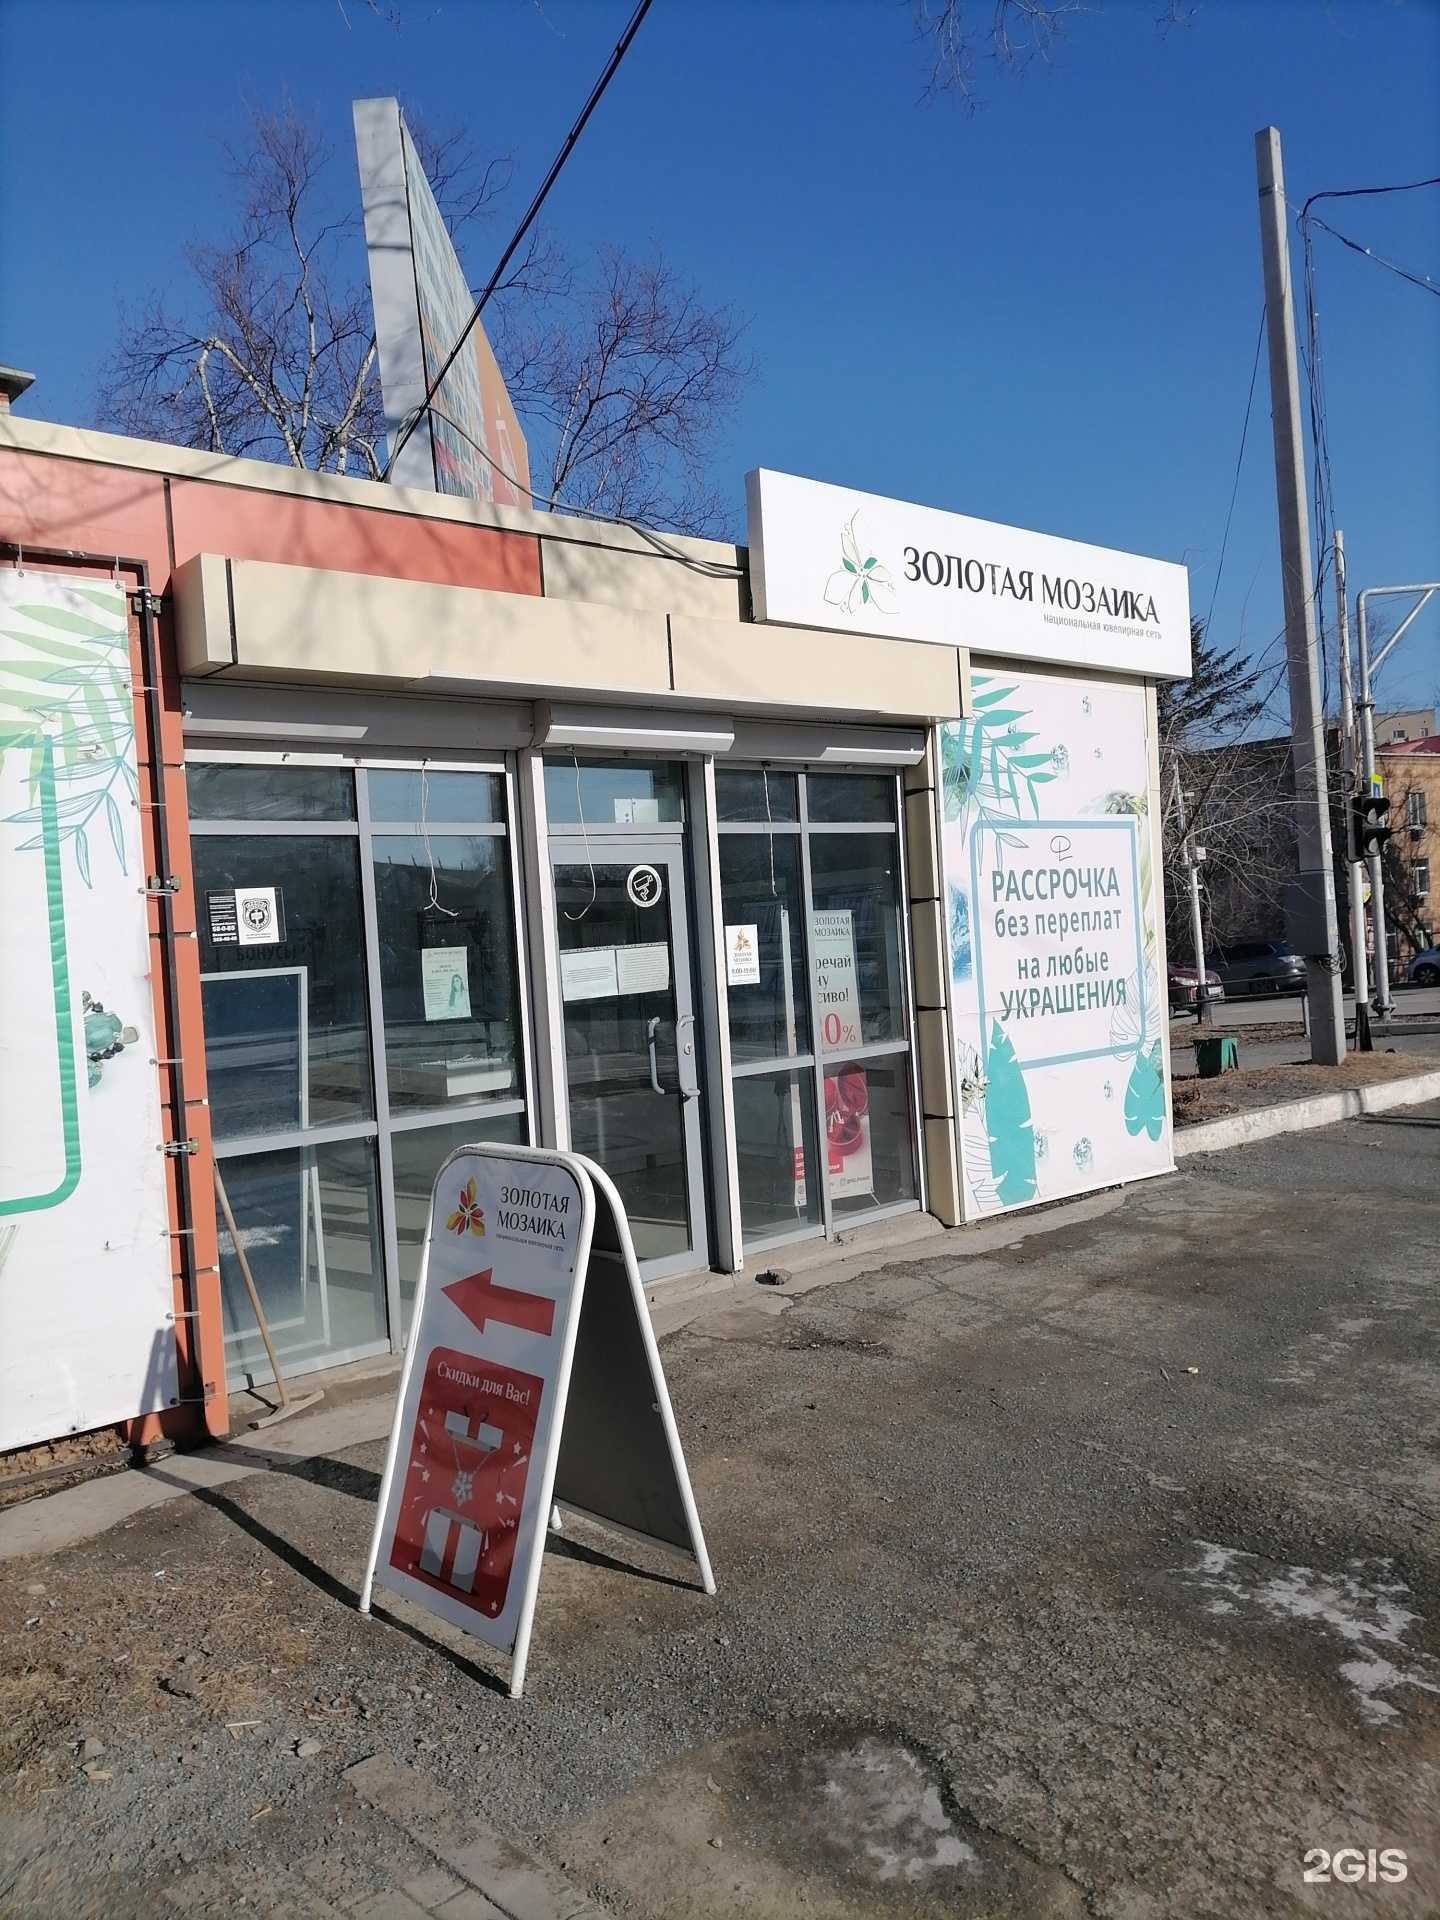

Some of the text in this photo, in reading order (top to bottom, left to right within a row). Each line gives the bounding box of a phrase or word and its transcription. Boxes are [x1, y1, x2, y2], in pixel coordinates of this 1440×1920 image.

[903, 546, 1160, 625] ЗОЛОТАЯ МОЗАИКА
[1043, 613, 1162, 640] национальная ювелирная сеть
[991, 867, 1121, 902] РАССРОЧКА
[995, 908, 1122, 942] без переплат
[1017, 946, 1109, 979] на любые
[1000, 978, 1127, 1021] УКРАШЕНИЯ
[500, 1186, 570, 1213] ЗОЛОТАЯ
[497, 1210, 566, 1240] МОЗАИКА
[437, 1361, 531, 1406] Скидки для Вас!
